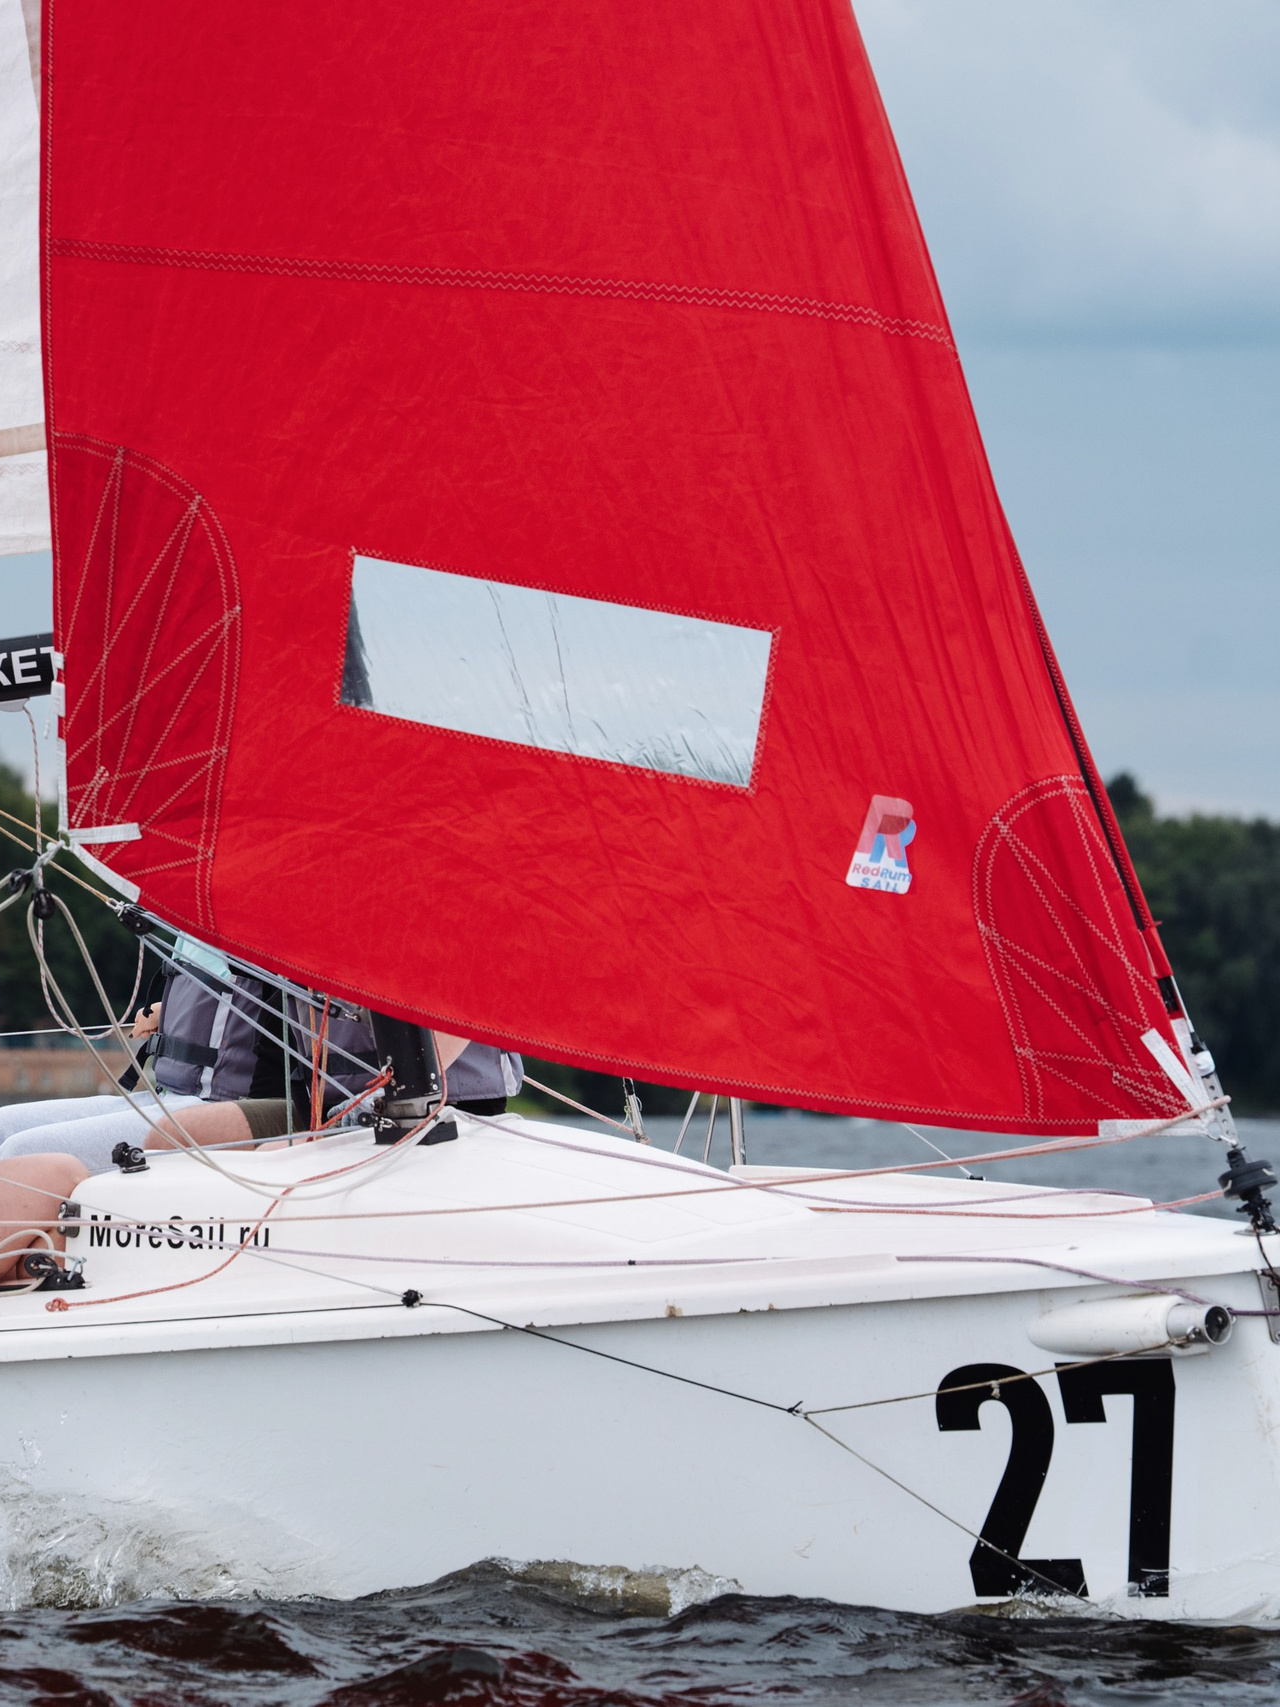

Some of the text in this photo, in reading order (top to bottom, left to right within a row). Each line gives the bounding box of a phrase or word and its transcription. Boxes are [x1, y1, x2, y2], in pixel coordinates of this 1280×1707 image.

[852, 863, 912, 882] RedRum
[860, 877, 900, 893] SAIL
[89, 1214, 270, 1251] MoreSailru
[936, 1358, 1175, 1597] 27
